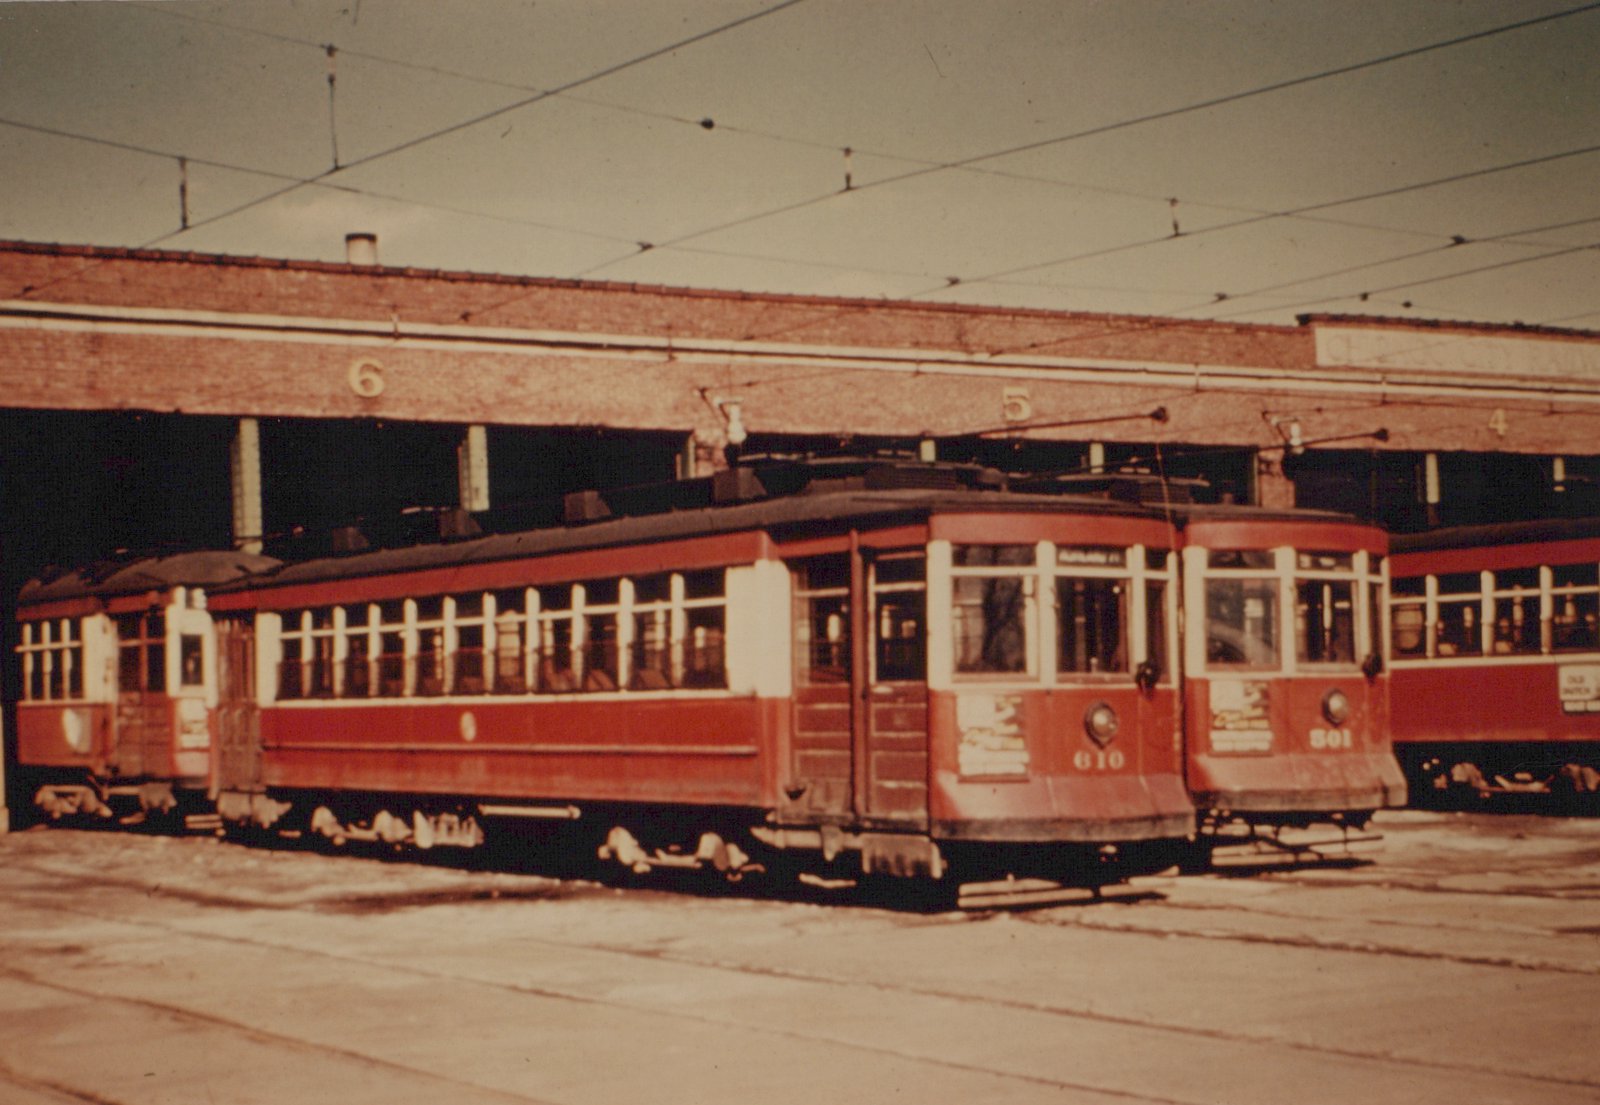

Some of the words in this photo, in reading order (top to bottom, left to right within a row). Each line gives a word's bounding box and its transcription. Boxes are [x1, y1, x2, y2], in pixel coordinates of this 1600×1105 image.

[348, 357, 385, 398] 6
[1003, 386, 1031, 421] 5
[1488, 408, 1510, 436] 4
[1073, 750, 1125, 770] 610
